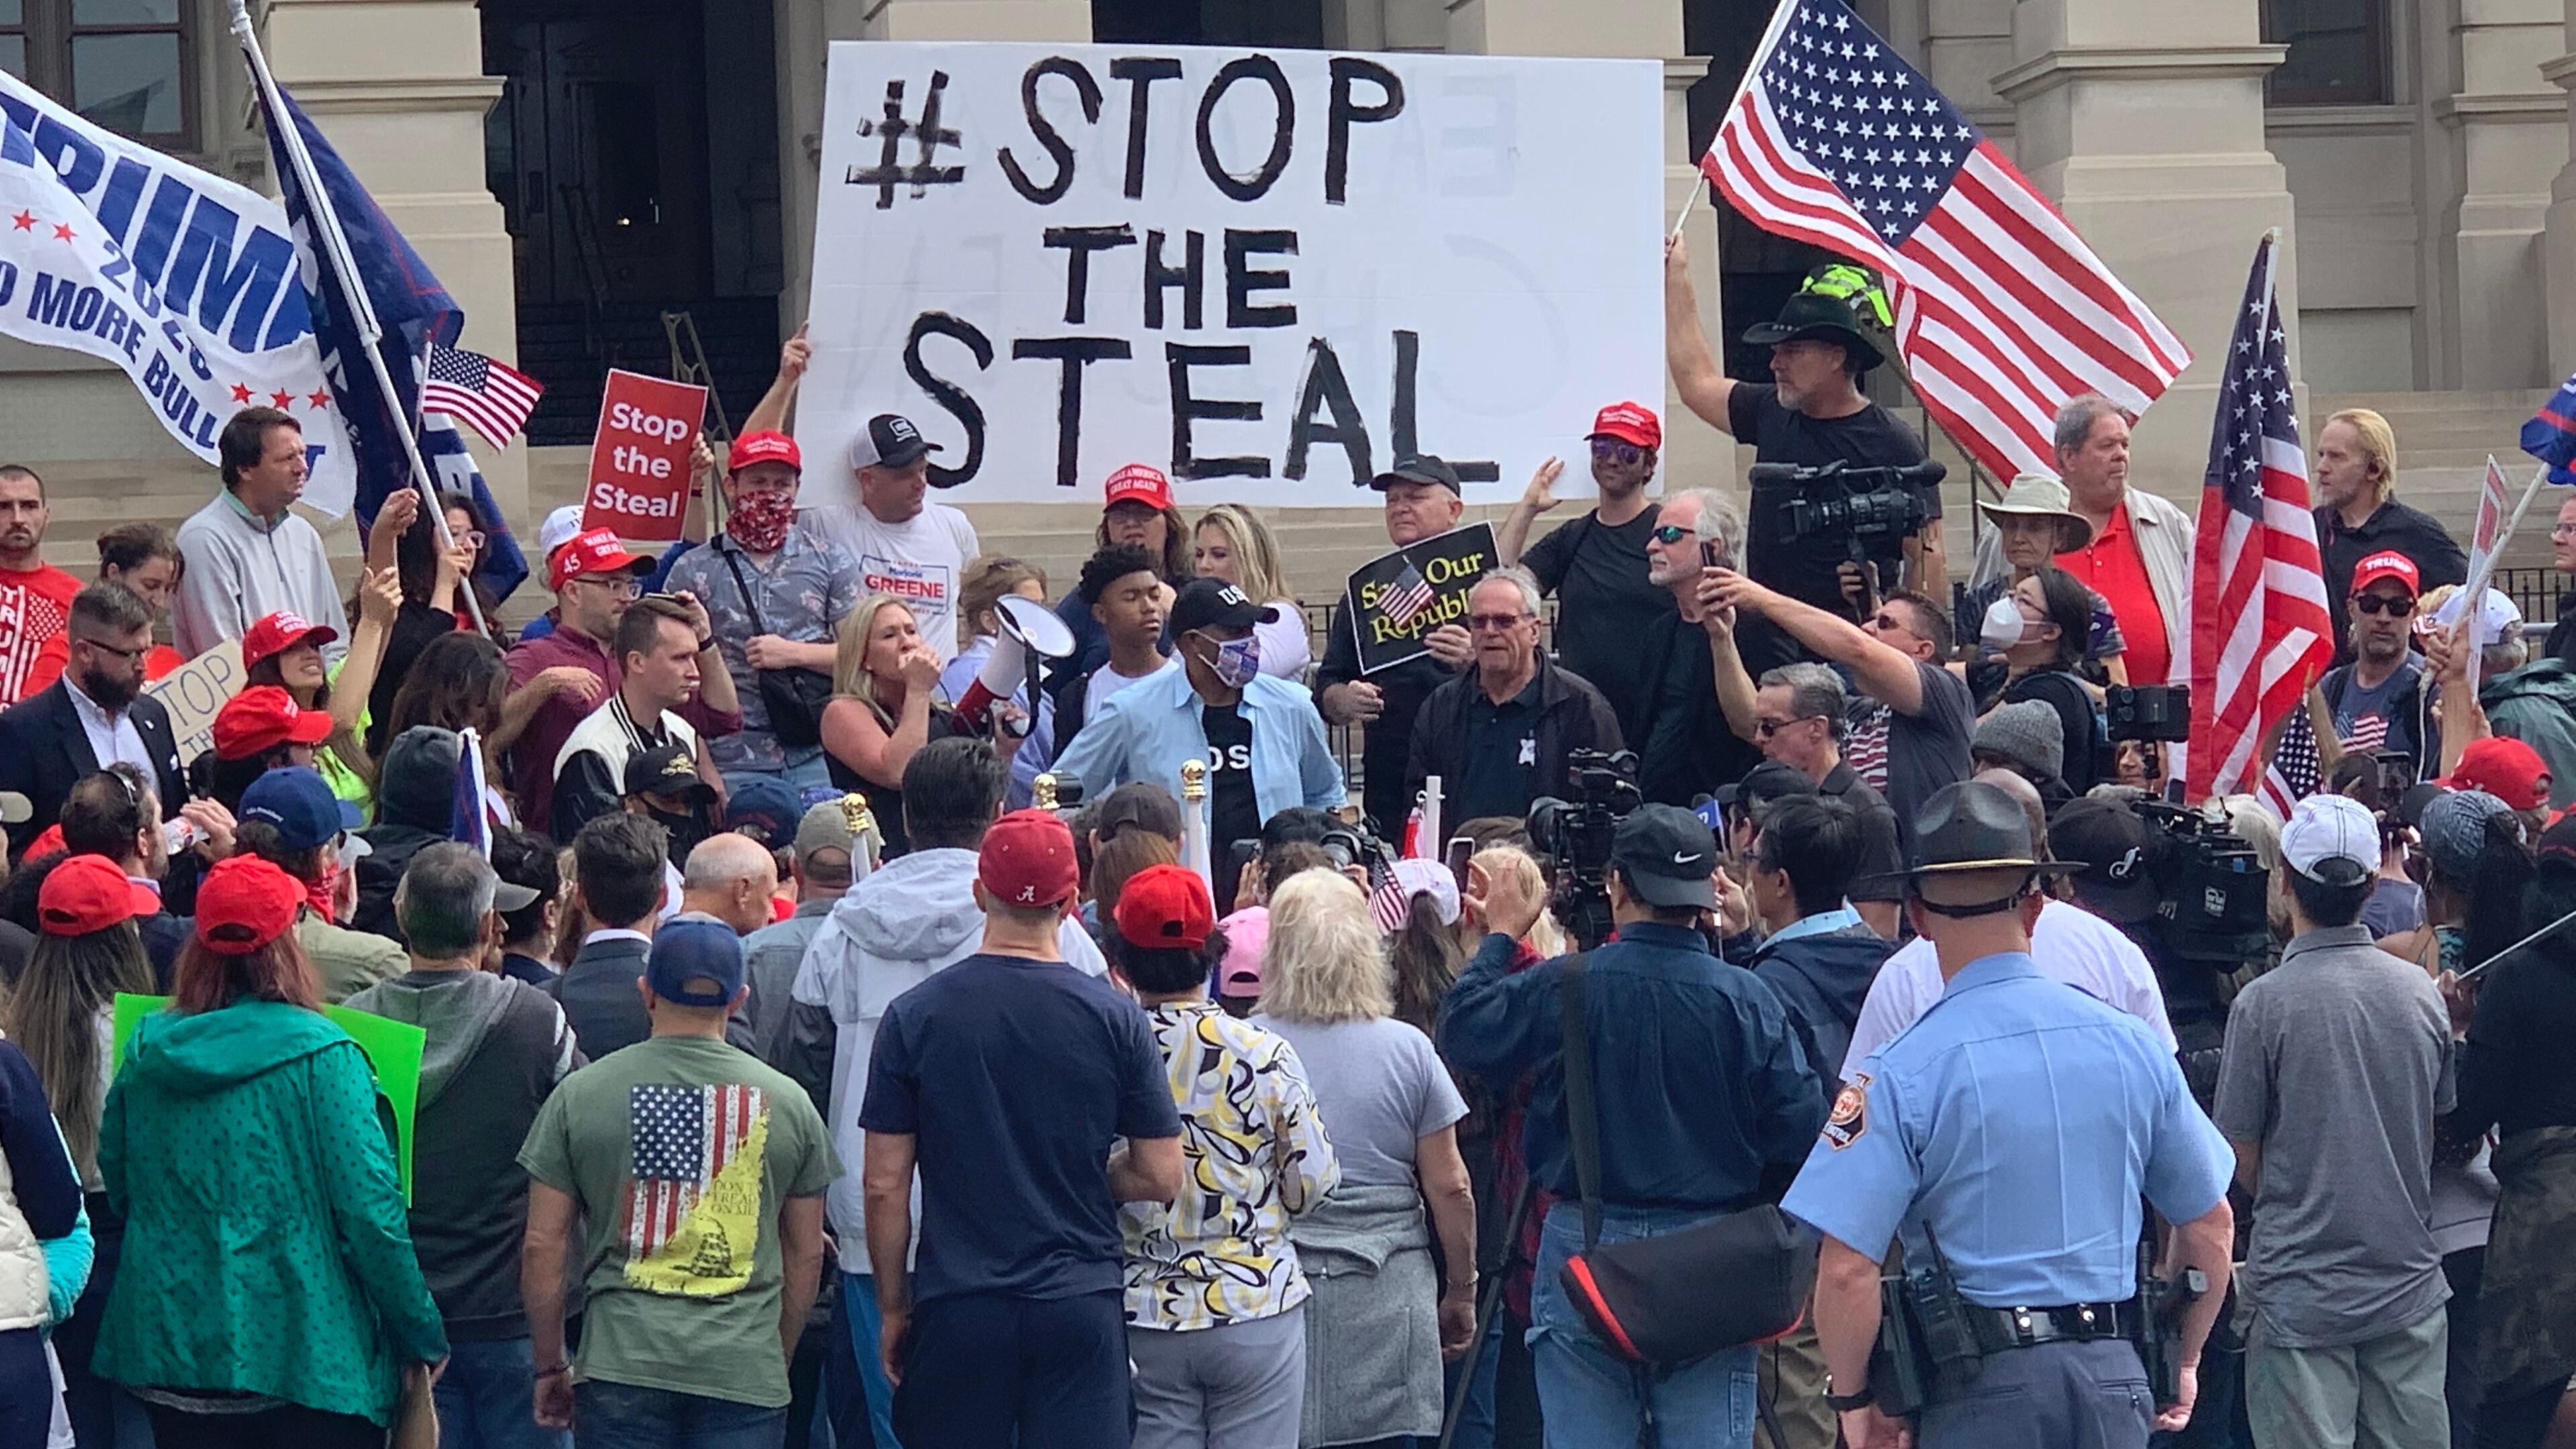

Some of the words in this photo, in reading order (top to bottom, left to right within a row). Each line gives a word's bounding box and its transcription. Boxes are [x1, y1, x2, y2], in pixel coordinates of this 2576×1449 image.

[1043, 223, 1299, 330] THE
[27, 271, 146, 363] MORE
[904, 311, 1499, 490] STEAL
[610, 402, 688, 445] Stop
[613, 445, 672, 478] the
[593, 482, 680, 517] Steal
[563, 552, 582, 574] 45
[1426, 552, 1485, 584] Our
[2365, 556, 2413, 574] TRUMP
[864, 574, 945, 599] GREENE
[1369, 587, 1470, 645] Republ
[149, 655, 232, 727] TOP
